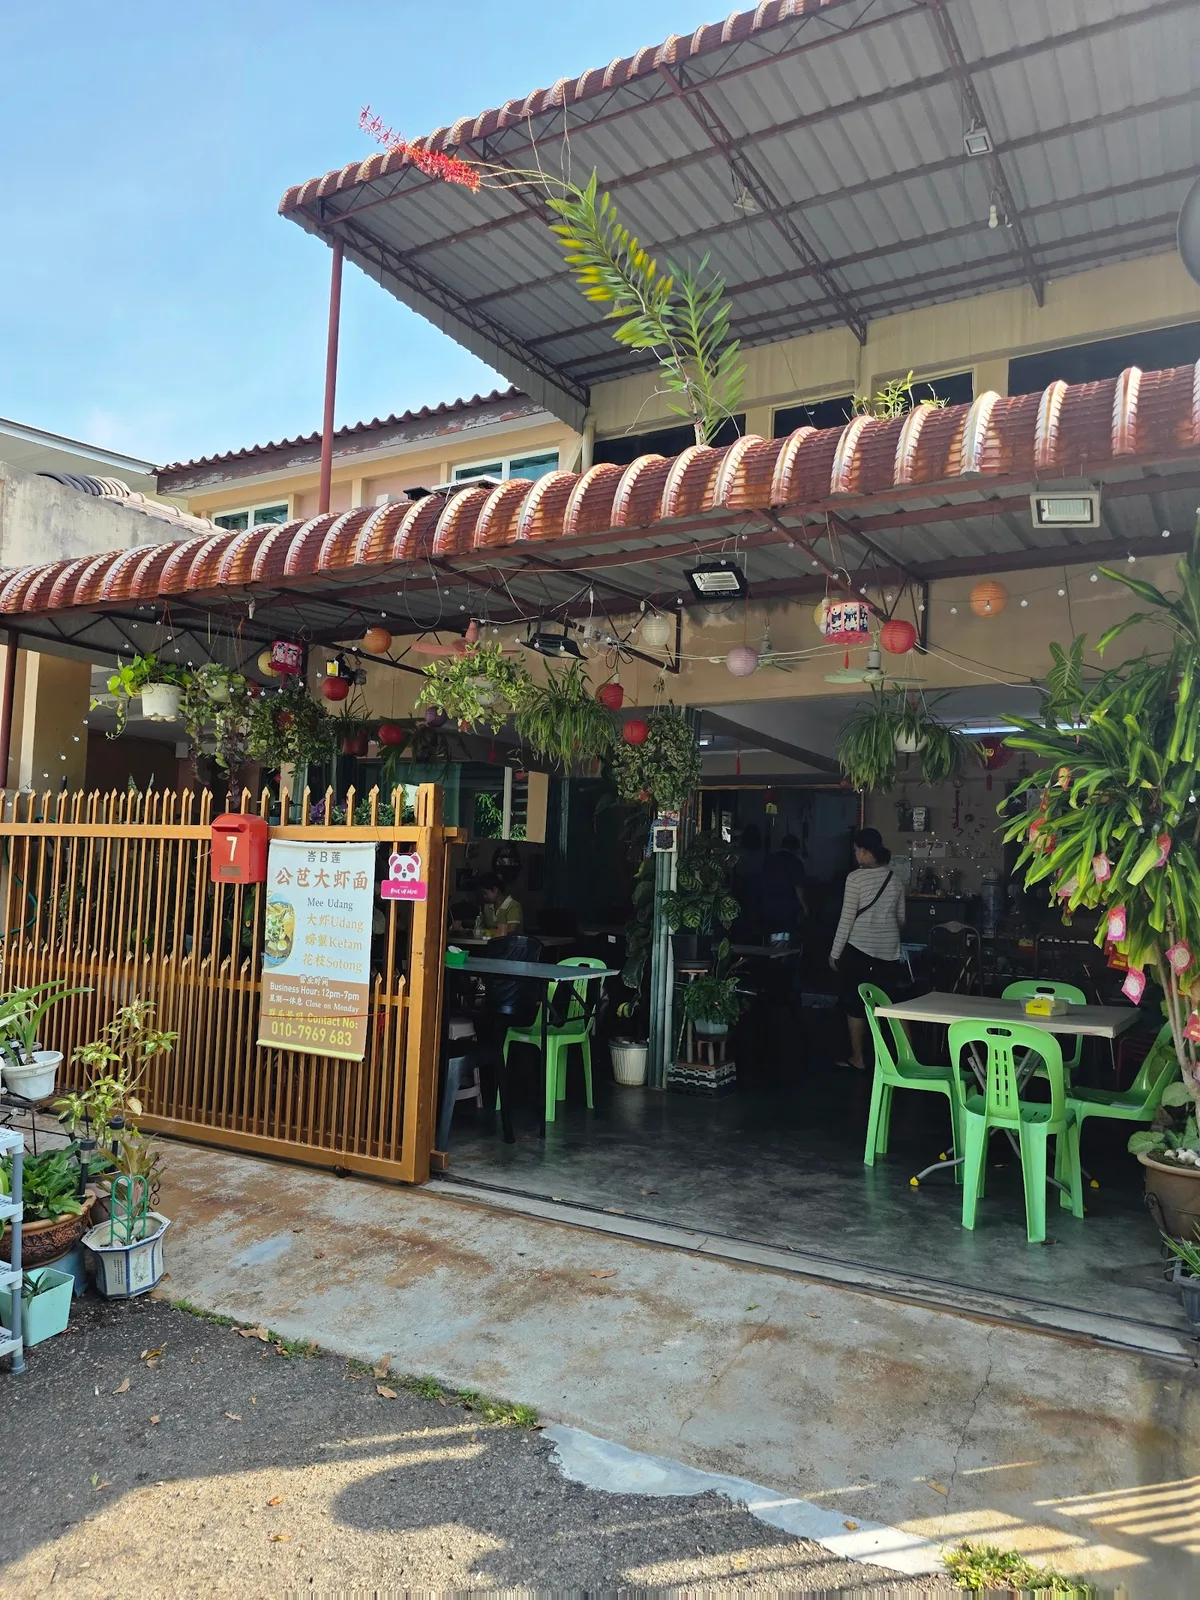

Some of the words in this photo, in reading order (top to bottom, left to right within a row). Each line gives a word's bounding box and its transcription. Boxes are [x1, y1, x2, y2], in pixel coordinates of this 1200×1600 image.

[226, 836, 238, 861] 7
[275, 867, 368, 890] 公芭大虾面
[307, 897, 324, 907] Mee
[327, 899, 354, 912] Udang
[269, 981, 299, 994] Business
[300, 985, 320, 996] Hour:
[321, 988, 360, 1001] 12pm-7pm
[268, 994, 303, 1006] 星期一休息
[305, 999, 322, 1009] Close
[333, 1003, 360, 1014] Monday
[307, 1012, 340, 1026] Contact
[342, 1017, 358, 1029] No:
[271, 1021, 326, 1042] 010-7969
[329, 1029, 352, 1046] 683
